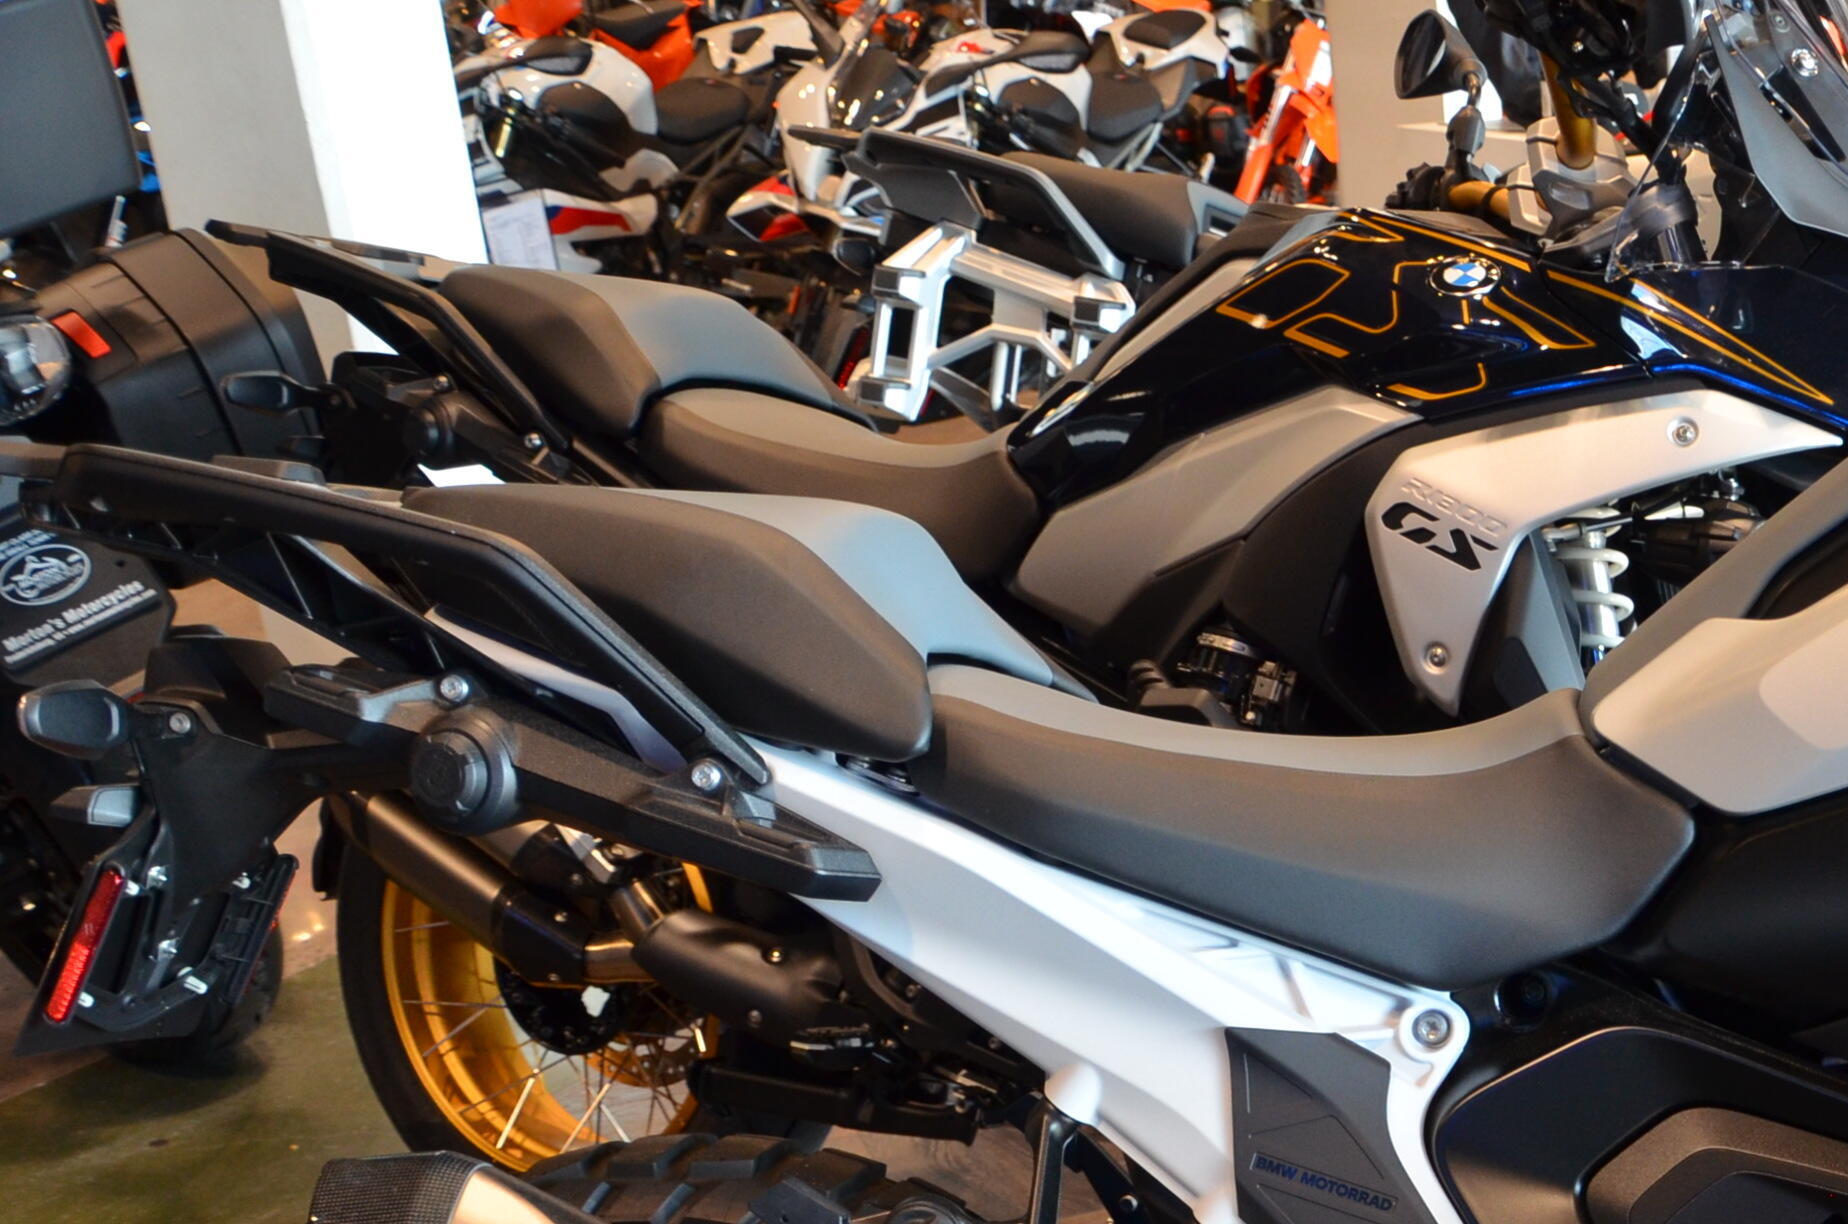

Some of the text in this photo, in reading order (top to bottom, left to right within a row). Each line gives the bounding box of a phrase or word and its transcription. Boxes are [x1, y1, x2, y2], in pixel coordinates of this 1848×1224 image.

[1381, 502, 1499, 571] GS
[1255, 1155, 1393, 1211] BMW MOTORRAD
